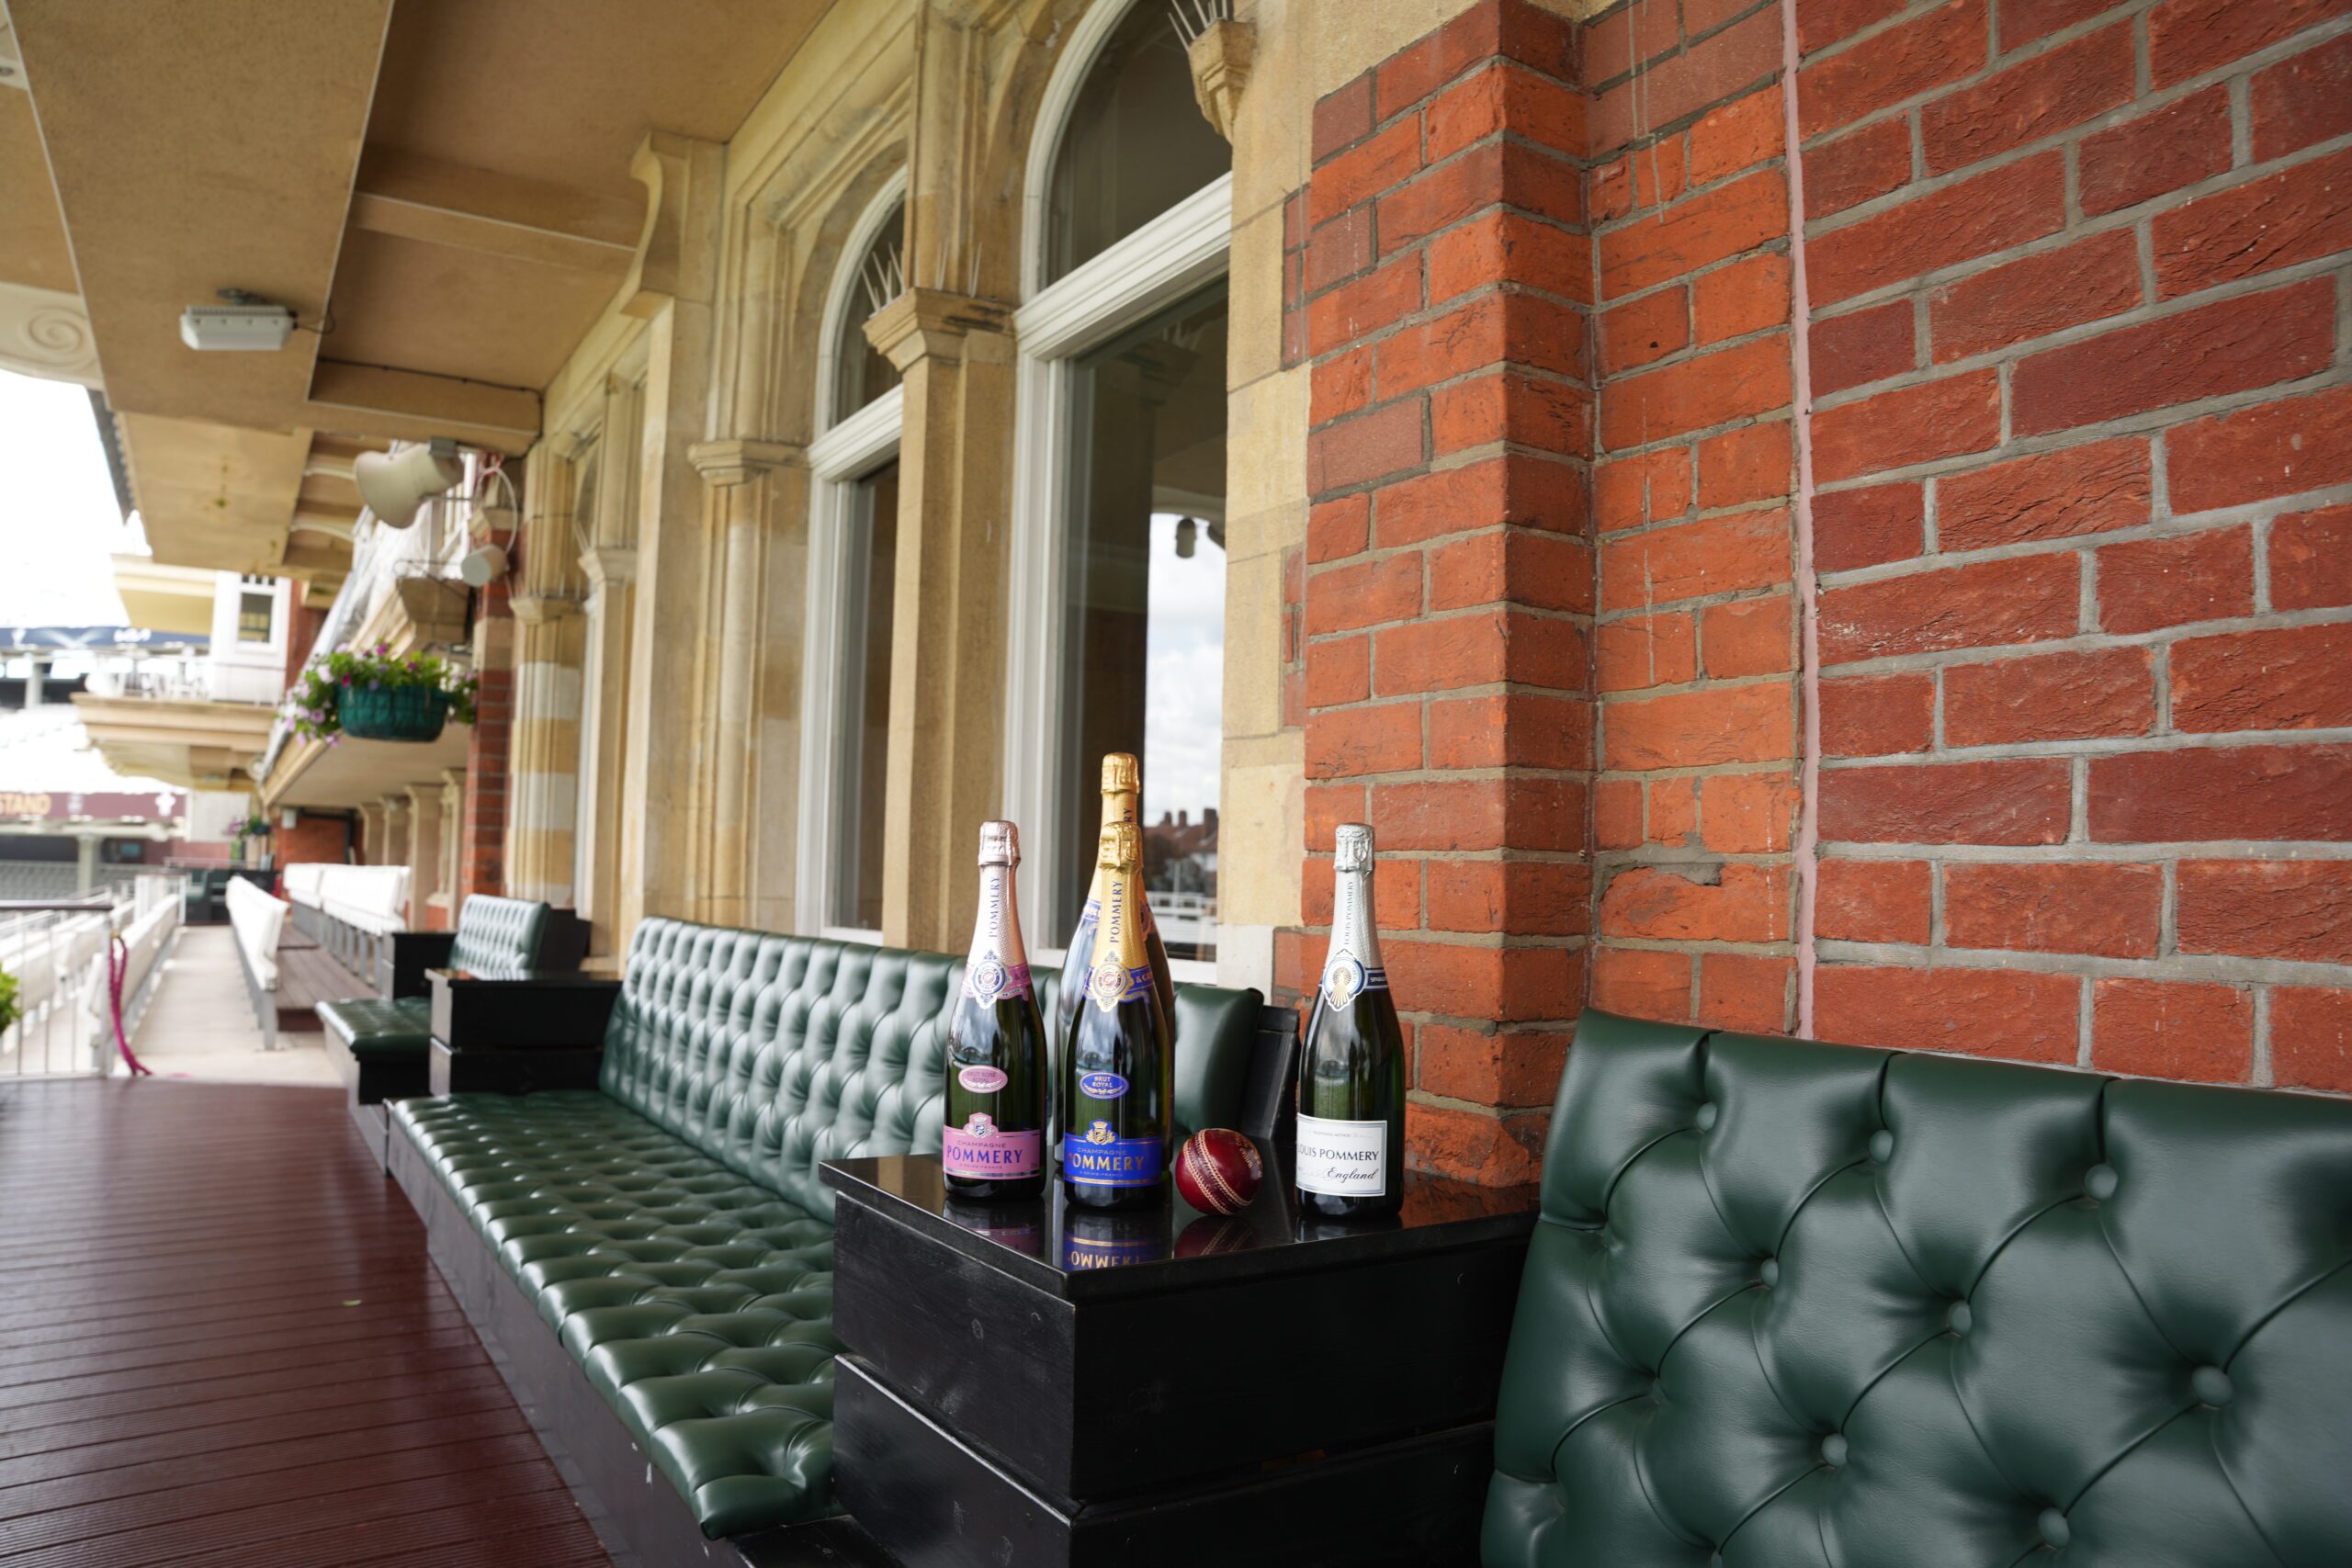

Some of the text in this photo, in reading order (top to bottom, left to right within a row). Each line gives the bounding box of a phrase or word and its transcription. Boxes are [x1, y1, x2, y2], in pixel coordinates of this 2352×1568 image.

[989, 877, 1001, 938] POMMERY
[1110, 881, 1124, 943] POMMERY
[957, 1140, 1007, 1148] CHAMPAGNE
[947, 1145, 1023, 1164] POMMERY
[1319, 1149, 1379, 1161] POMMERY
[1324, 1167, 1379, 1183] England
